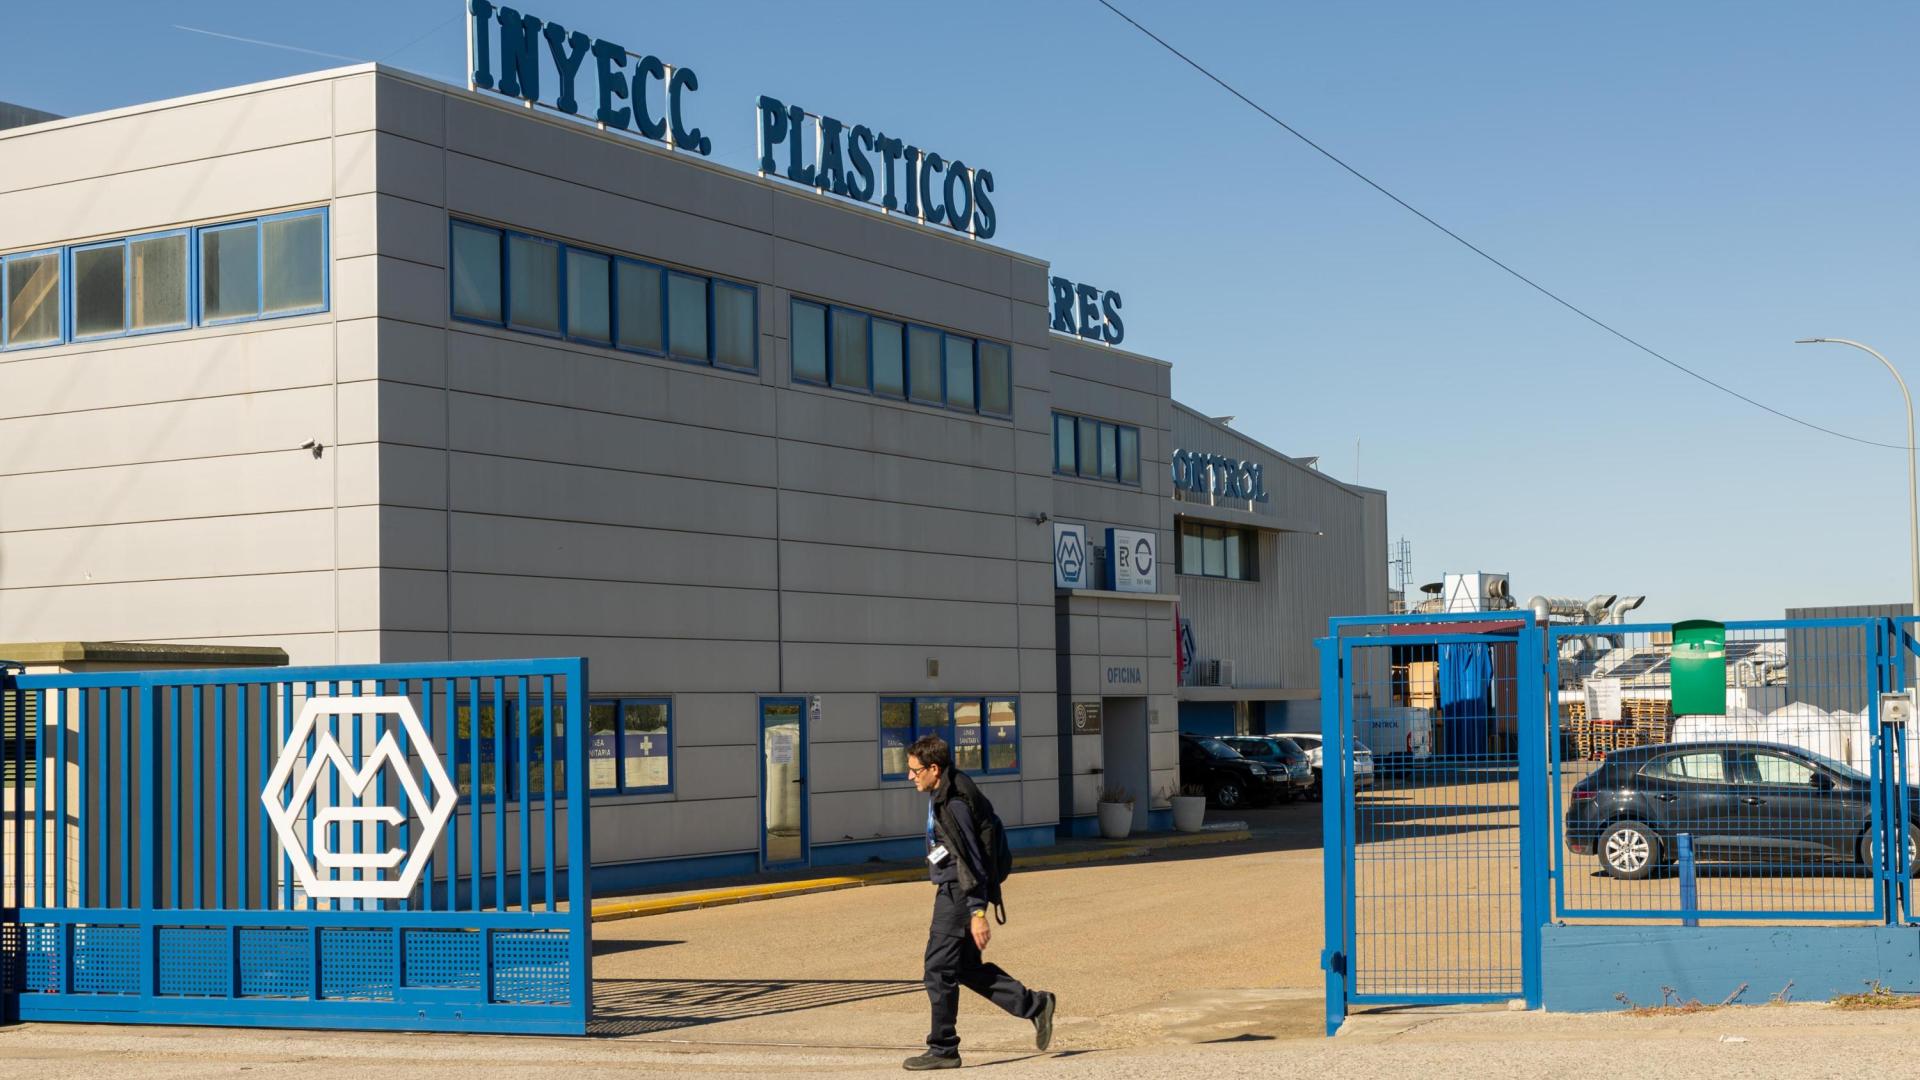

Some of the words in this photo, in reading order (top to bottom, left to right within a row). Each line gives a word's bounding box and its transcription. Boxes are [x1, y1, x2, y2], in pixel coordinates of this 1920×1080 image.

[469, 0, 711, 156] INYECC.
[756, 95, 996, 240] PLASTICOS
[1048, 276, 1125, 345] RES
[1107, 667, 1141, 683] OFICINA
